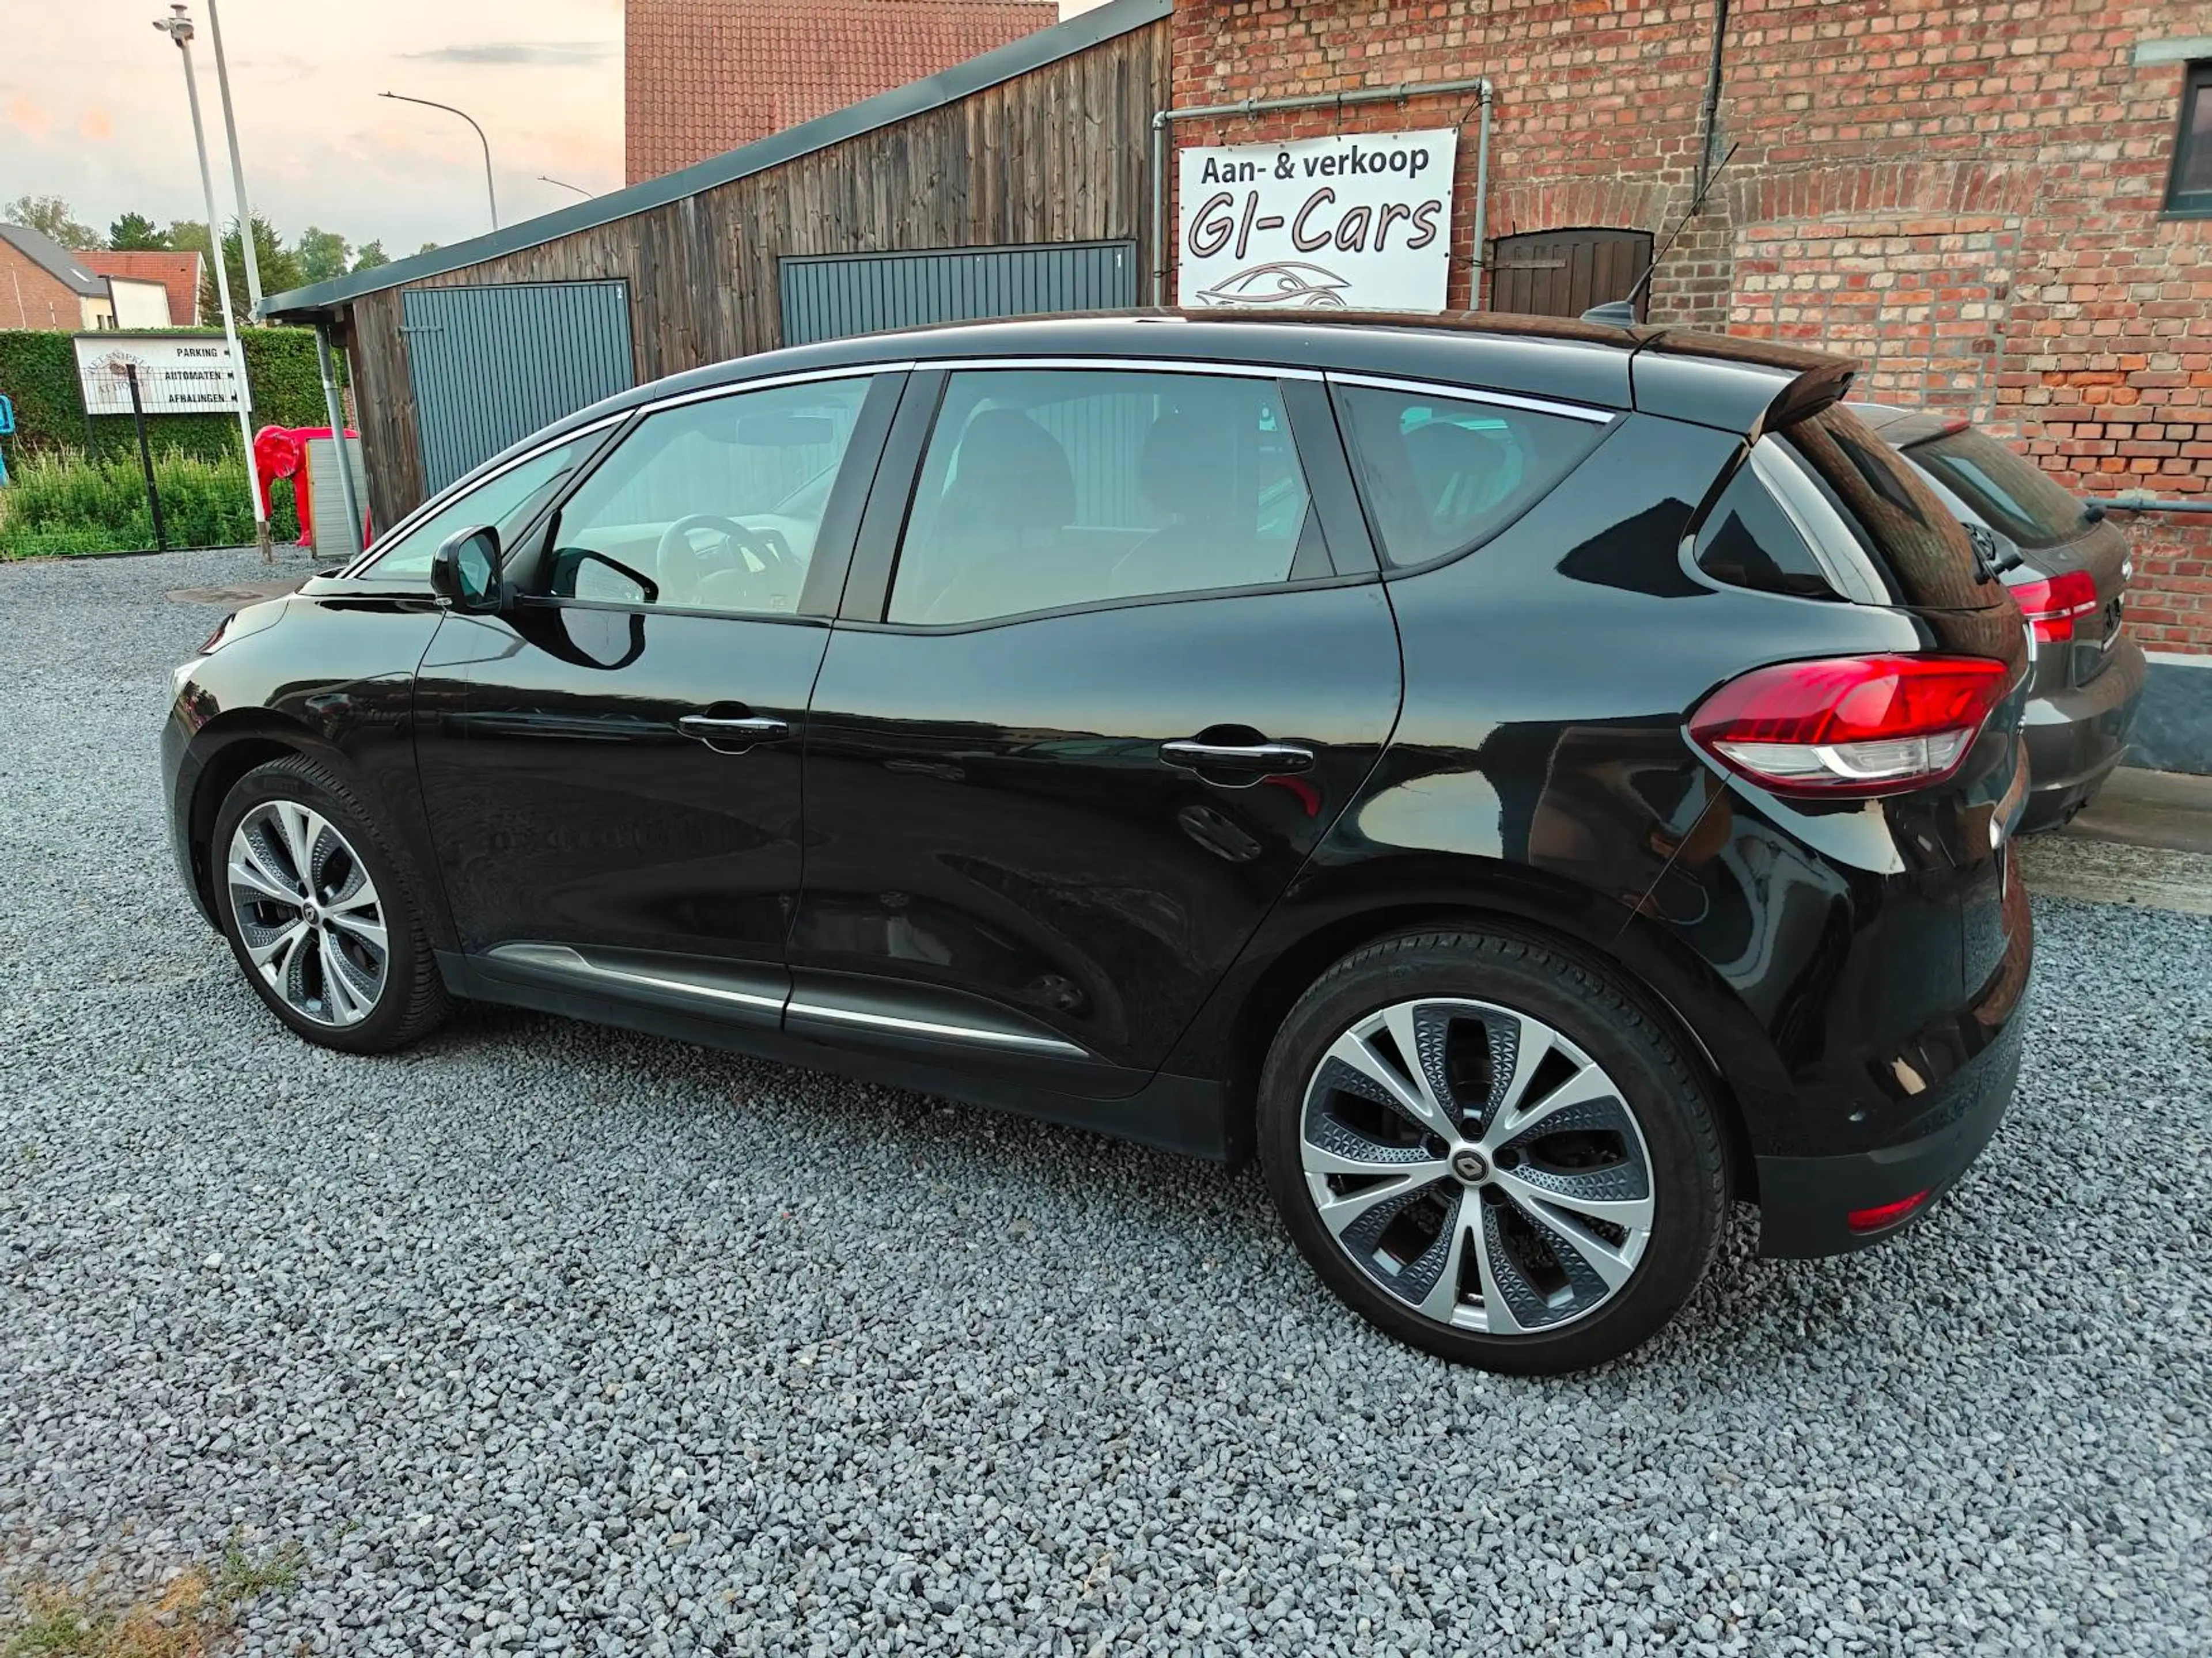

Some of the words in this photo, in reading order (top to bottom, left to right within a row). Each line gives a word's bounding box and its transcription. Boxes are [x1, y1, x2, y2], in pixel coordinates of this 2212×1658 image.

[1201, 157, 1267, 184] Aan-
[1274, 151, 1295, 179] &
[1304, 145, 1429, 178] verkoop
[177, 348, 217, 356] PARKING
[165, 371, 221, 380] AUTOMATEN
[169, 393, 225, 403] AFHALINGEN
